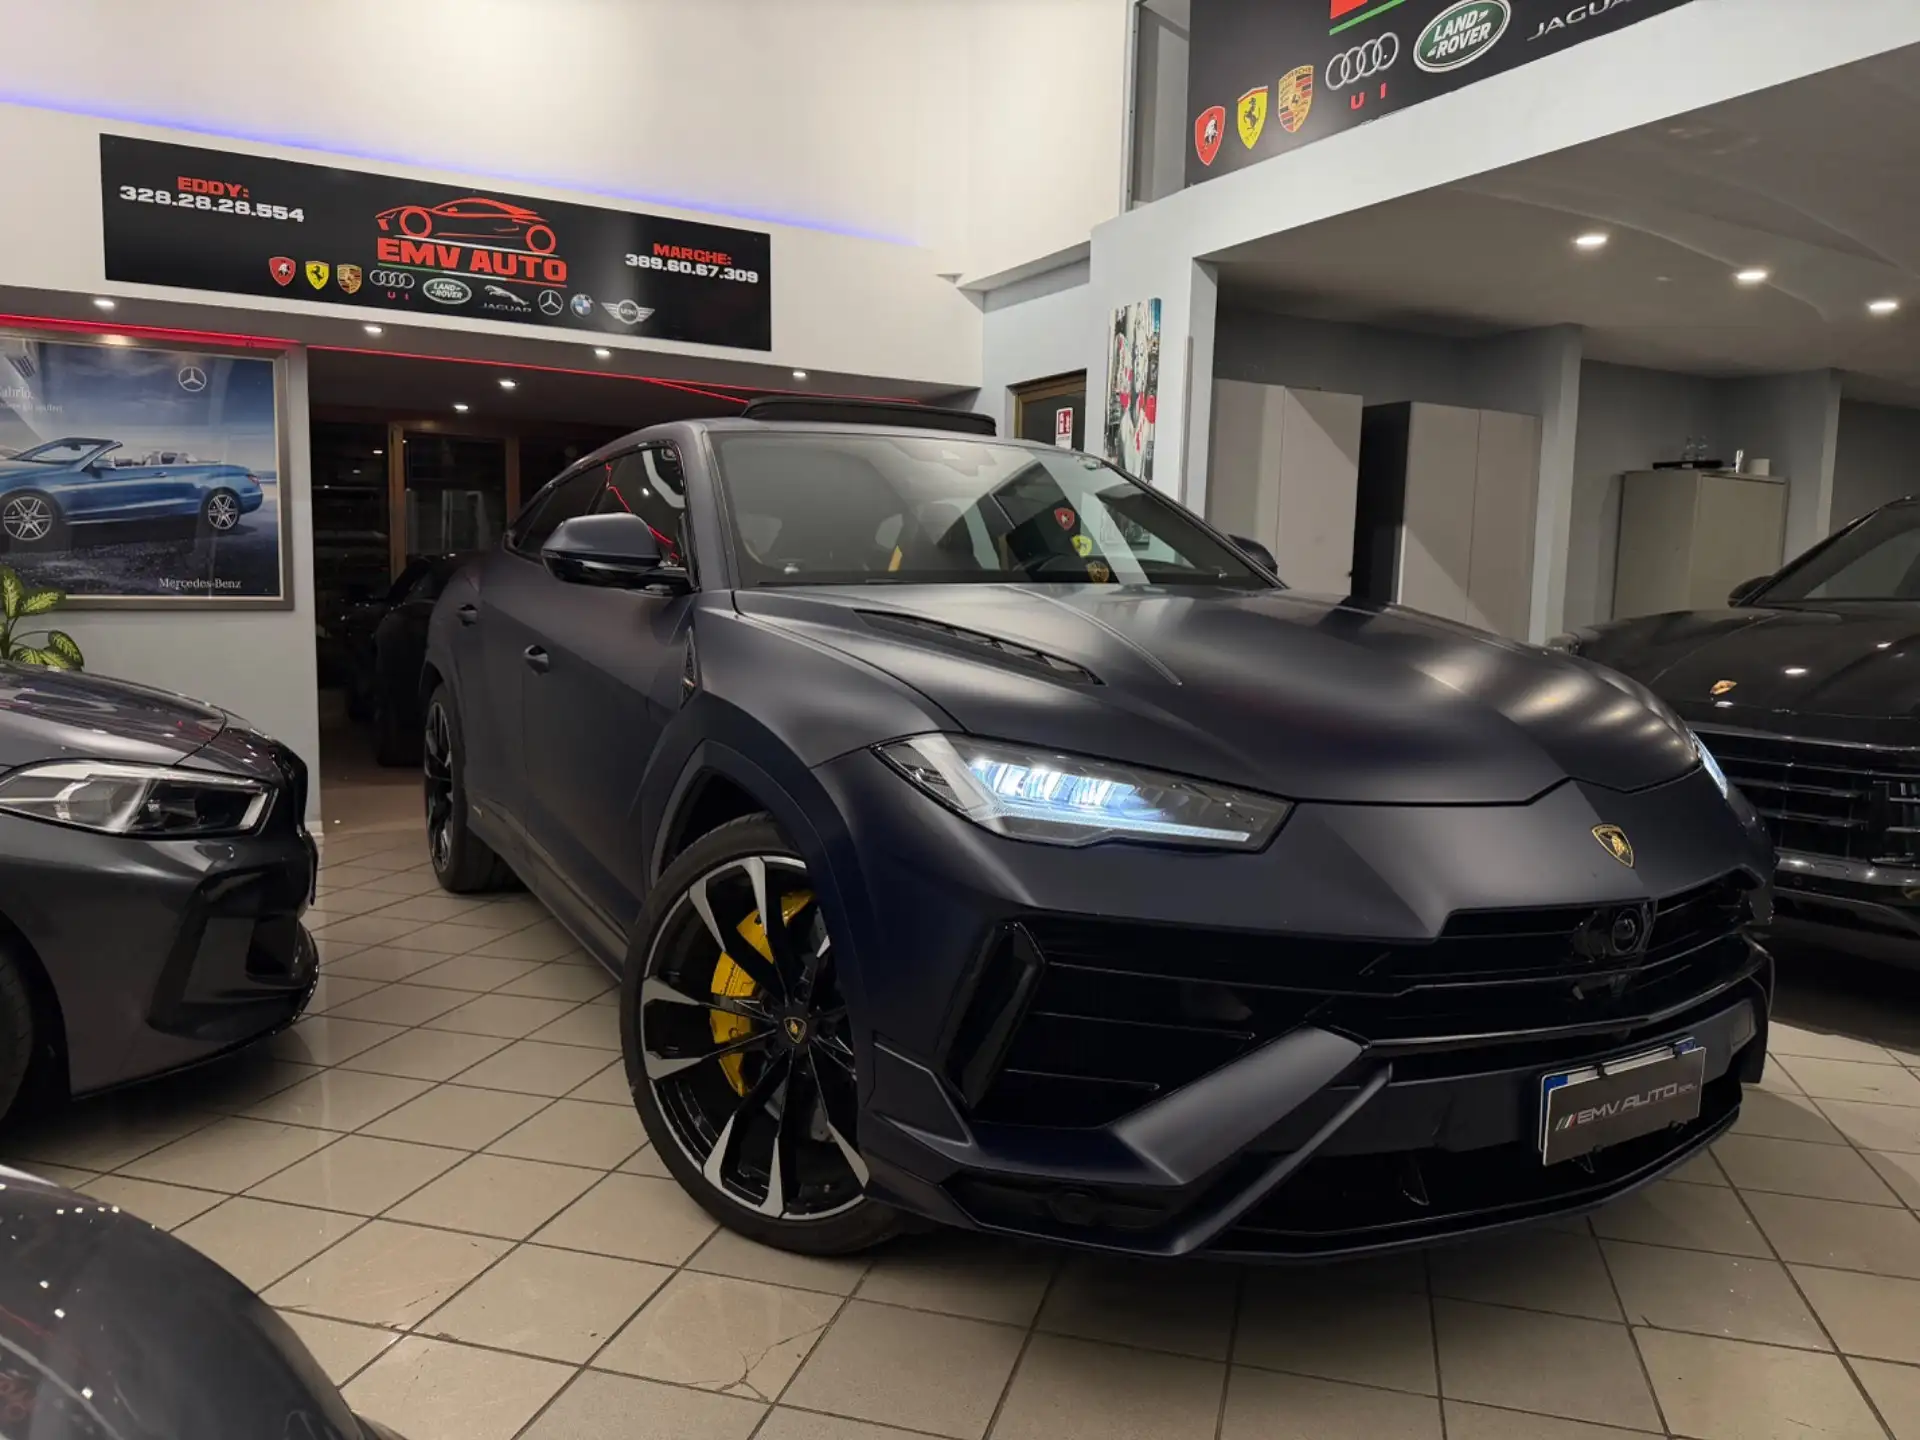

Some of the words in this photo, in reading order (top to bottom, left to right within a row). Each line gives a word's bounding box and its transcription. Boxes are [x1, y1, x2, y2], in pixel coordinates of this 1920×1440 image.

[1433, 10, 1478, 43] LAND
[1526, 0, 1632, 41] JAGU
[1436, 22, 1492, 59] ROVER
[177, 176, 249, 198] EDDY:
[119, 185, 304, 223] 328.28.28.554
[377, 236, 461, 269] EMV
[469, 249, 567, 282] AUTO
[625, 253, 759, 284] 389.60.67.309
[433, 282, 456, 292] LAND
[435, 288, 463, 299] ROVER
[159, 577, 242, 591] Mercedes-Benz
[1577, 1100, 1620, 1124] EMV
[1621, 1083, 1677, 1112] AUTO
